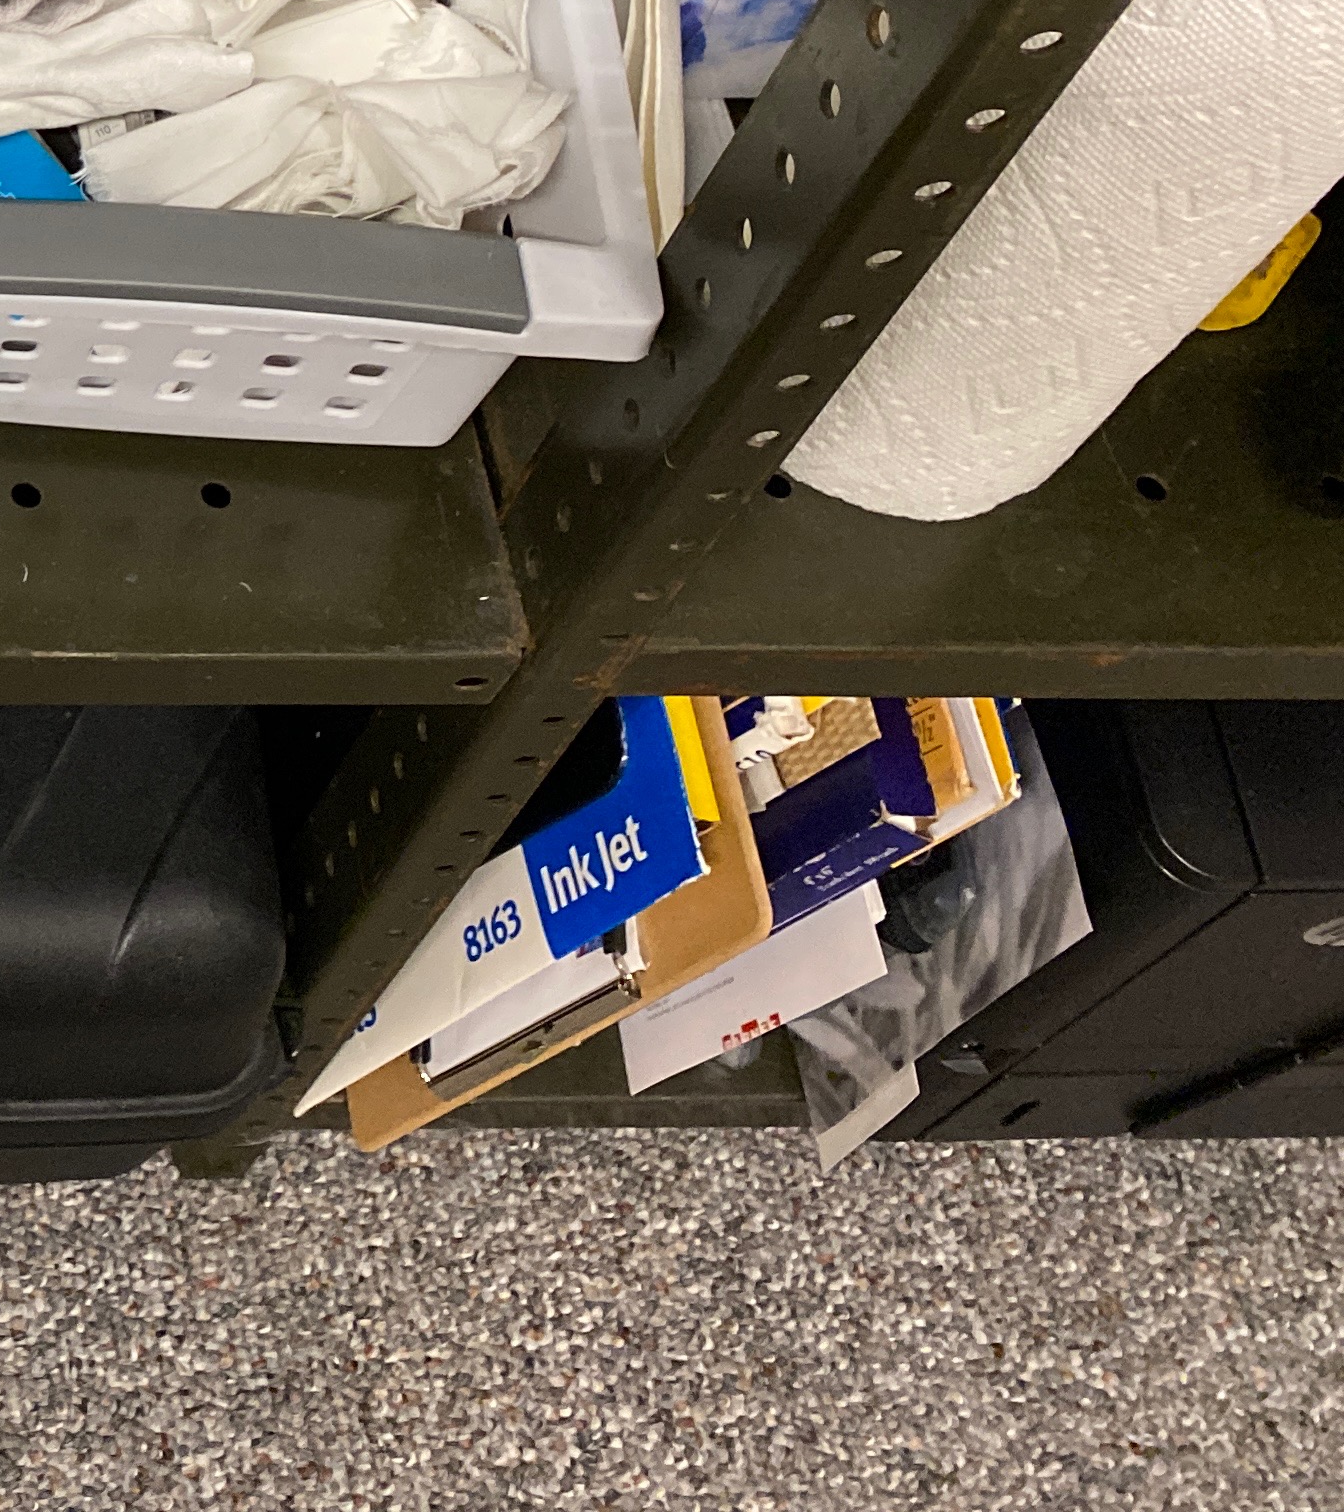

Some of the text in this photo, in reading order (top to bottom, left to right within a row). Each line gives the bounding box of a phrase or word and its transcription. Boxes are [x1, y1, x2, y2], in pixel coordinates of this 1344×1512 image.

[94, 125, 111, 137] 110
[539, 815, 648, 914] Ink Jet
[463, 899, 522, 962] 8163
